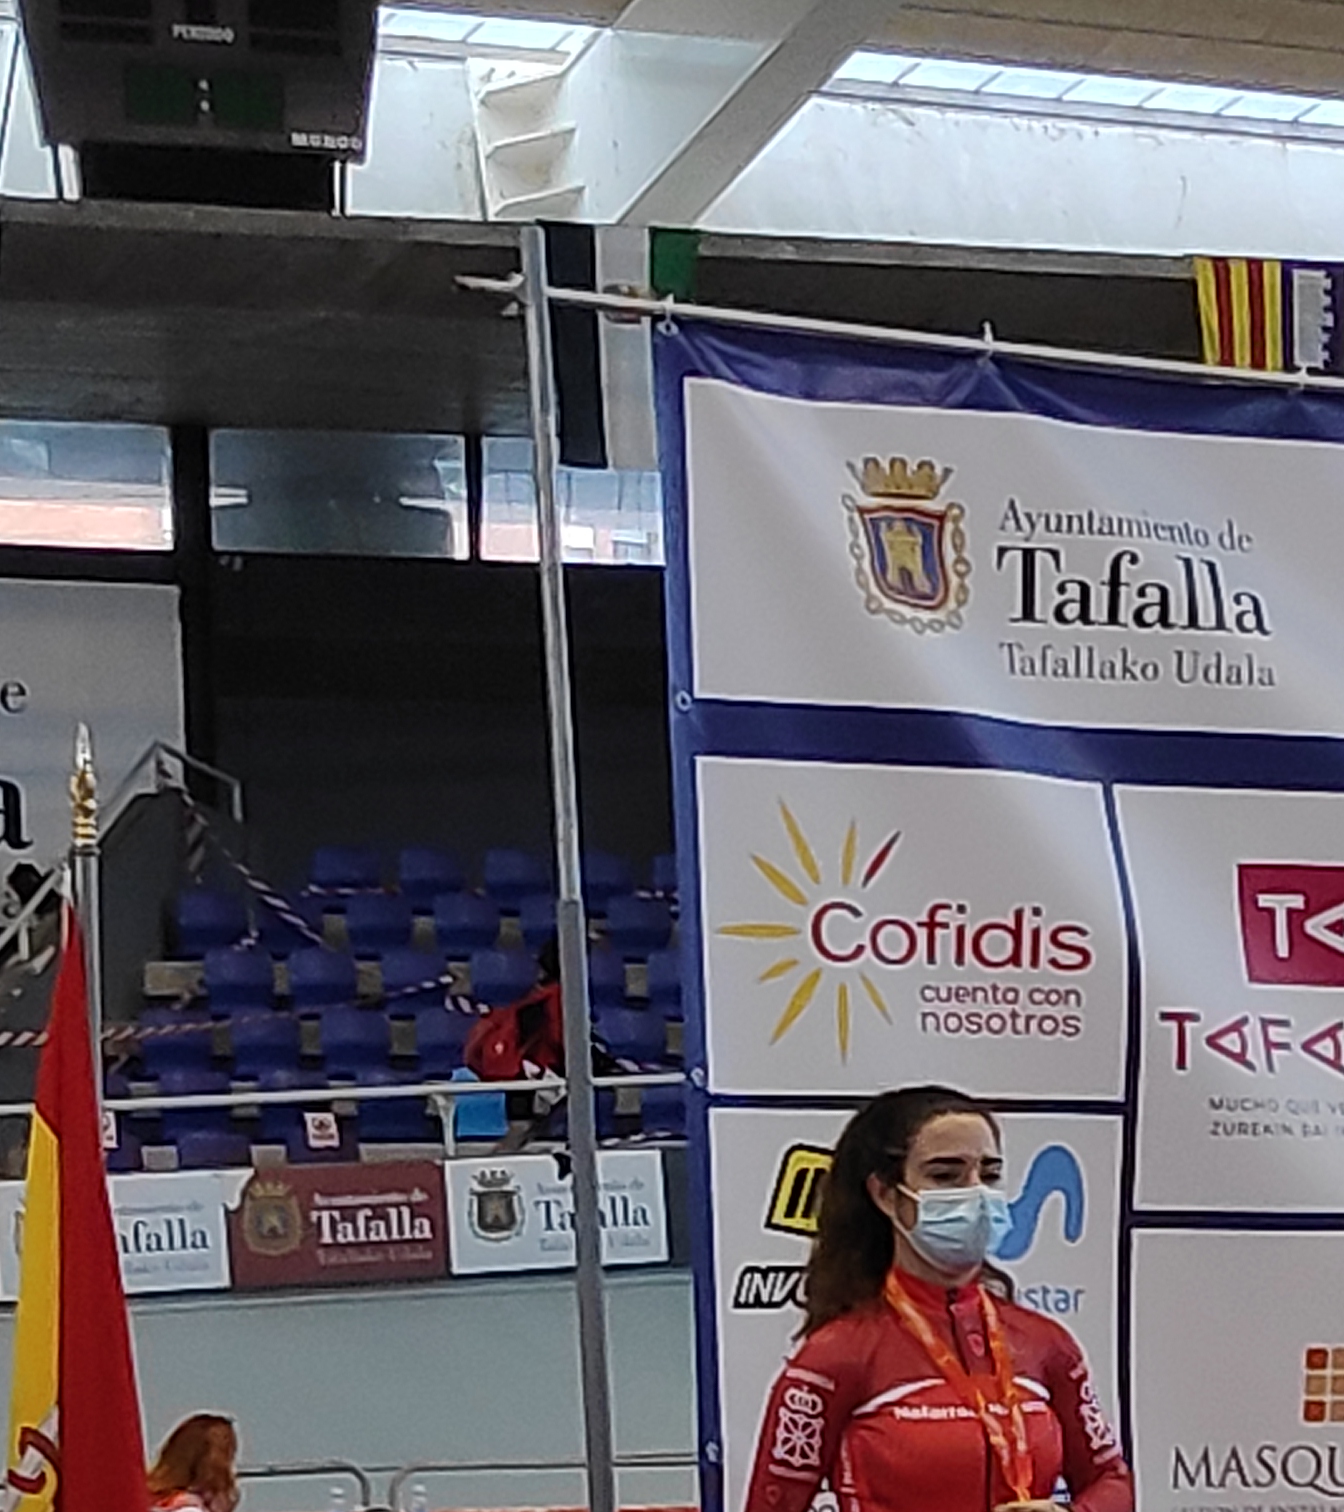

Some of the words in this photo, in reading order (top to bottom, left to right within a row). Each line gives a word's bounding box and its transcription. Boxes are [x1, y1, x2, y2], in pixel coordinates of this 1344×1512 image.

[1000, 499, 1210, 550] Ayuntamiento
[1219, 517, 1254, 553] de
[997, 545, 1271, 637] Tafalla
[1000, 643, 1160, 684] Tafallako
[1173, 650, 1276, 687] Udala
[810, 900, 1094, 973] Cofidis
[919, 982, 1023, 1006] cuenta
[1028, 983, 1082, 1008] con
[919, 1007, 1082, 1038] nosotros
[310, 1205, 434, 1245] Tafalla
